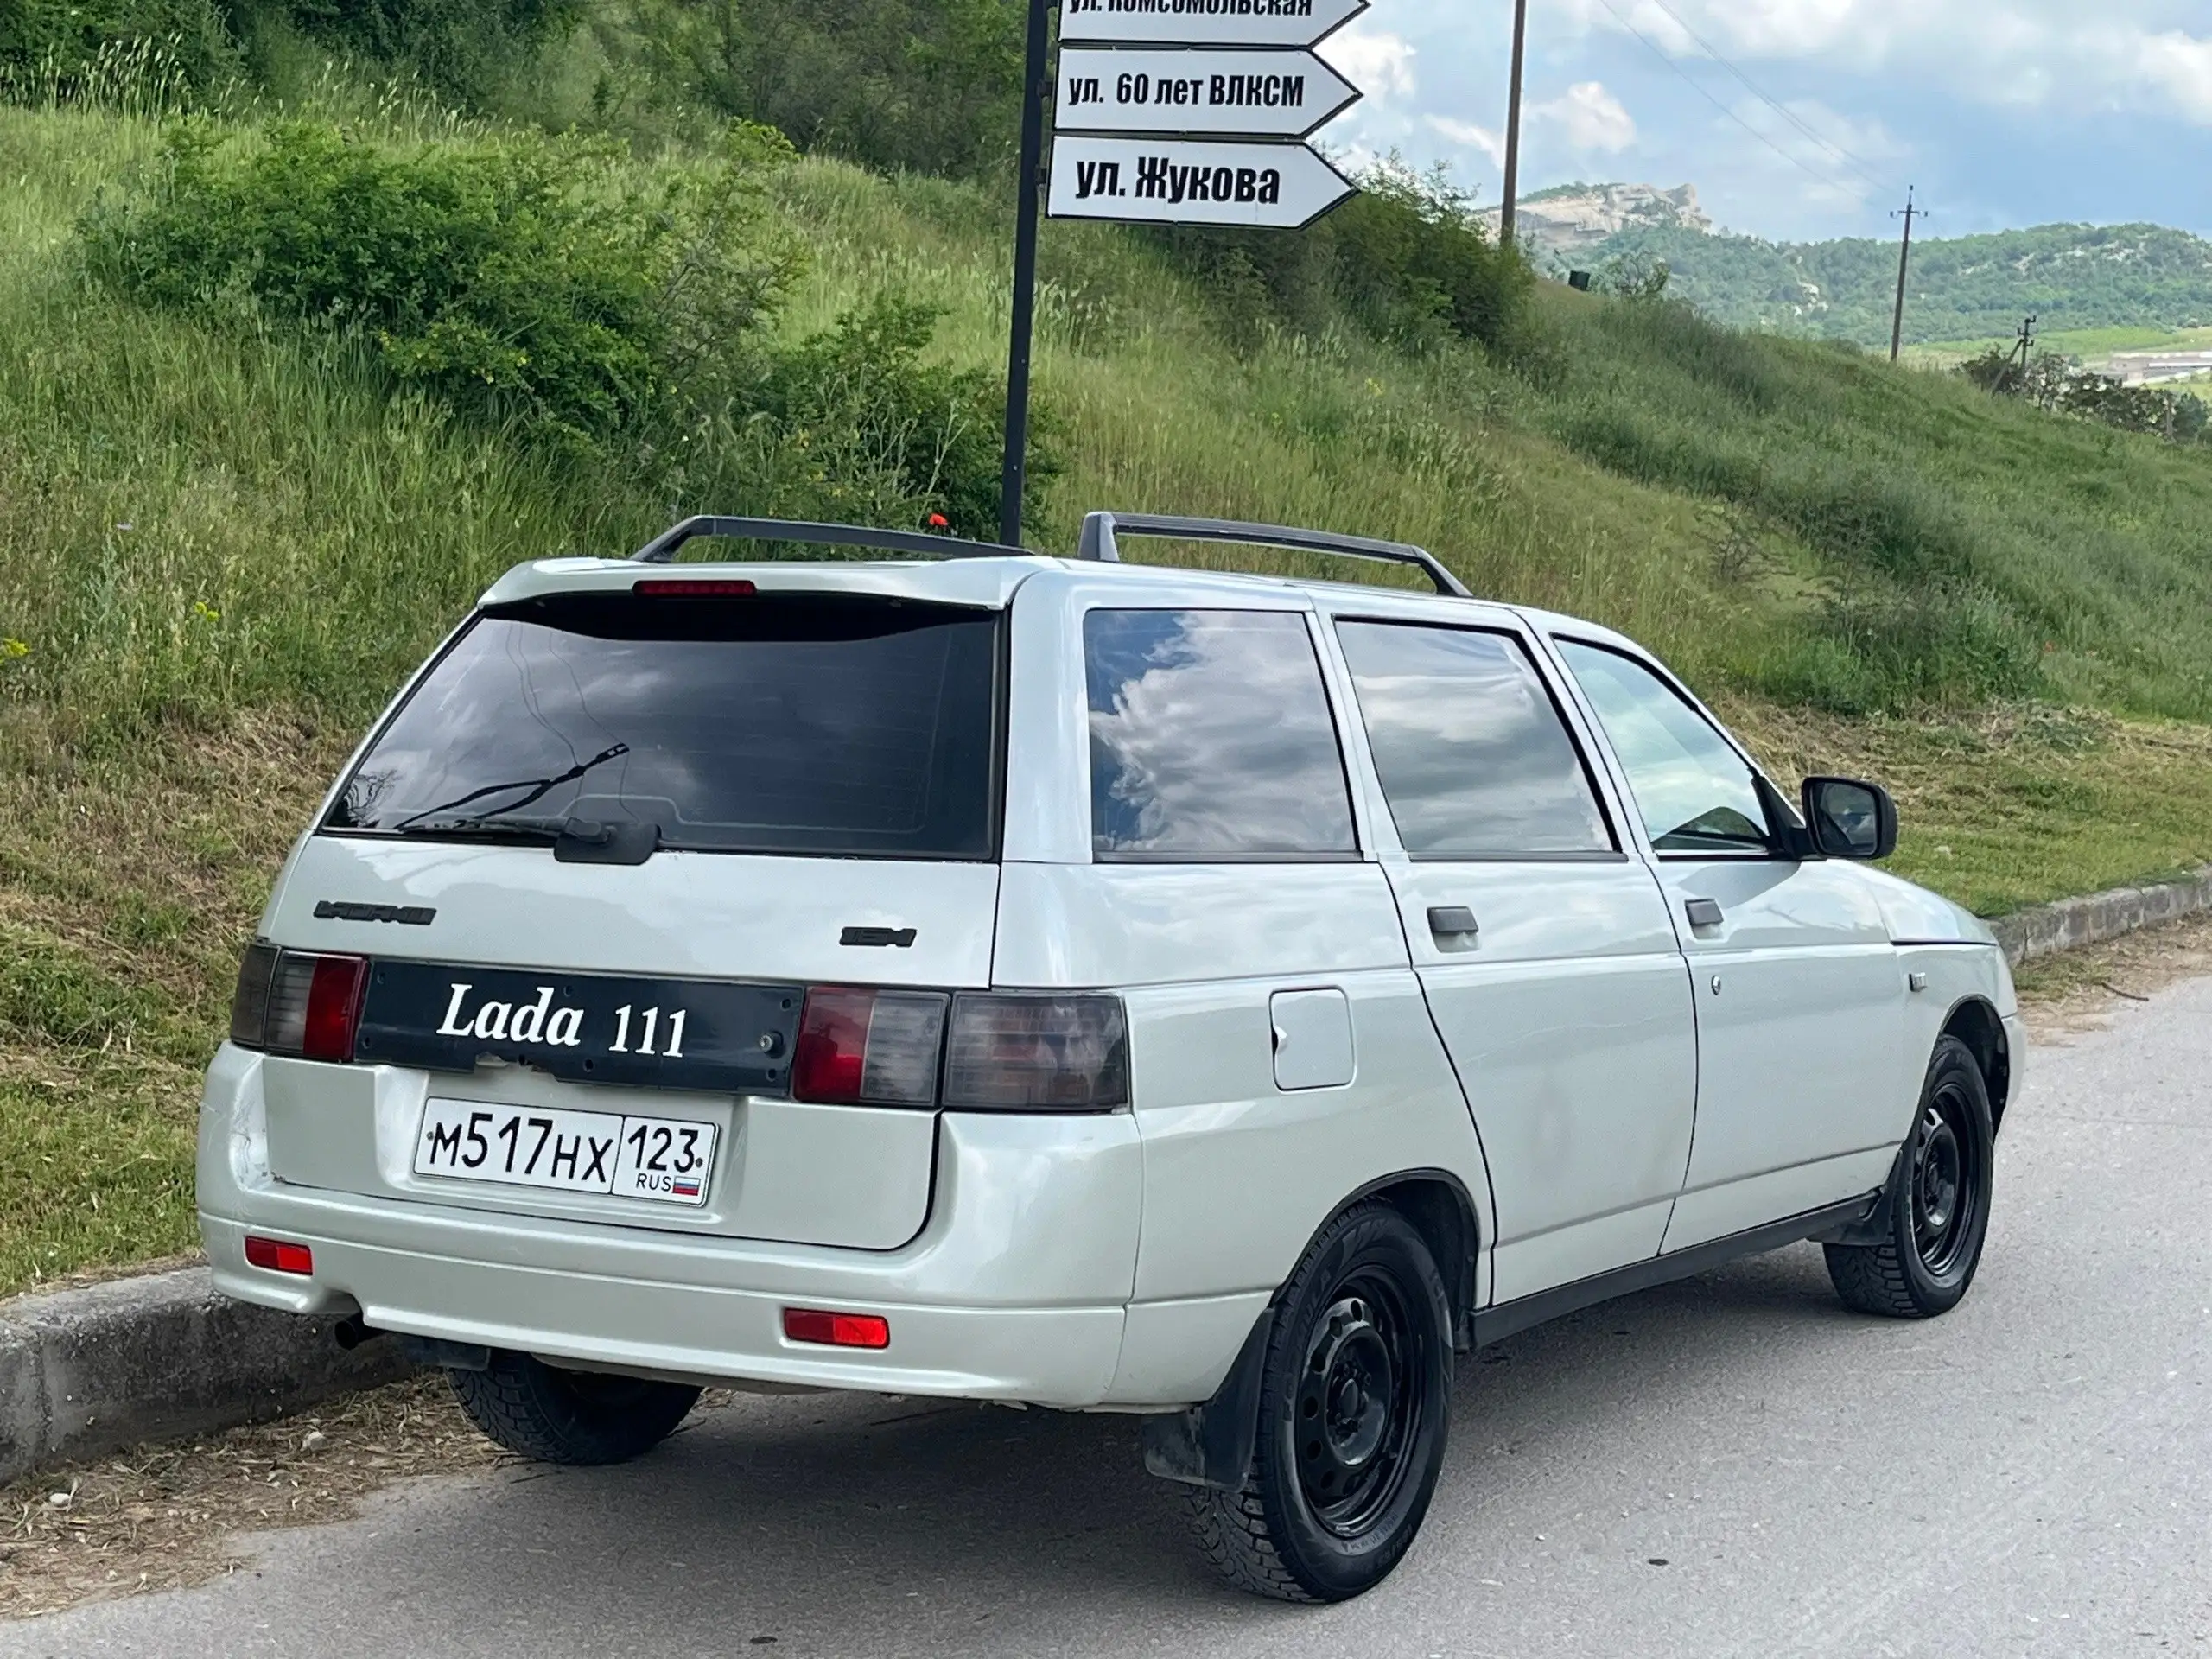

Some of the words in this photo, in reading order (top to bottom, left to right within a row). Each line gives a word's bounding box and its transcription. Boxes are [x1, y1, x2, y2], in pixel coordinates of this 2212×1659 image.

[1068, 78, 1104, 105] ул.
[1116, 73, 1149, 104] 60
[1154, 79, 1204, 105] лет
[1210, 74, 1304, 106] ВЛКСМ
[1076, 161, 1125, 199] ул.
[1135, 156, 1280, 204] Жукова
[436, 983, 584, 1046] Lada
[609, 1004, 686, 1058] 111
[628, 1124, 699, 1173] 123
[636, 1173, 671, 1192] RUS
